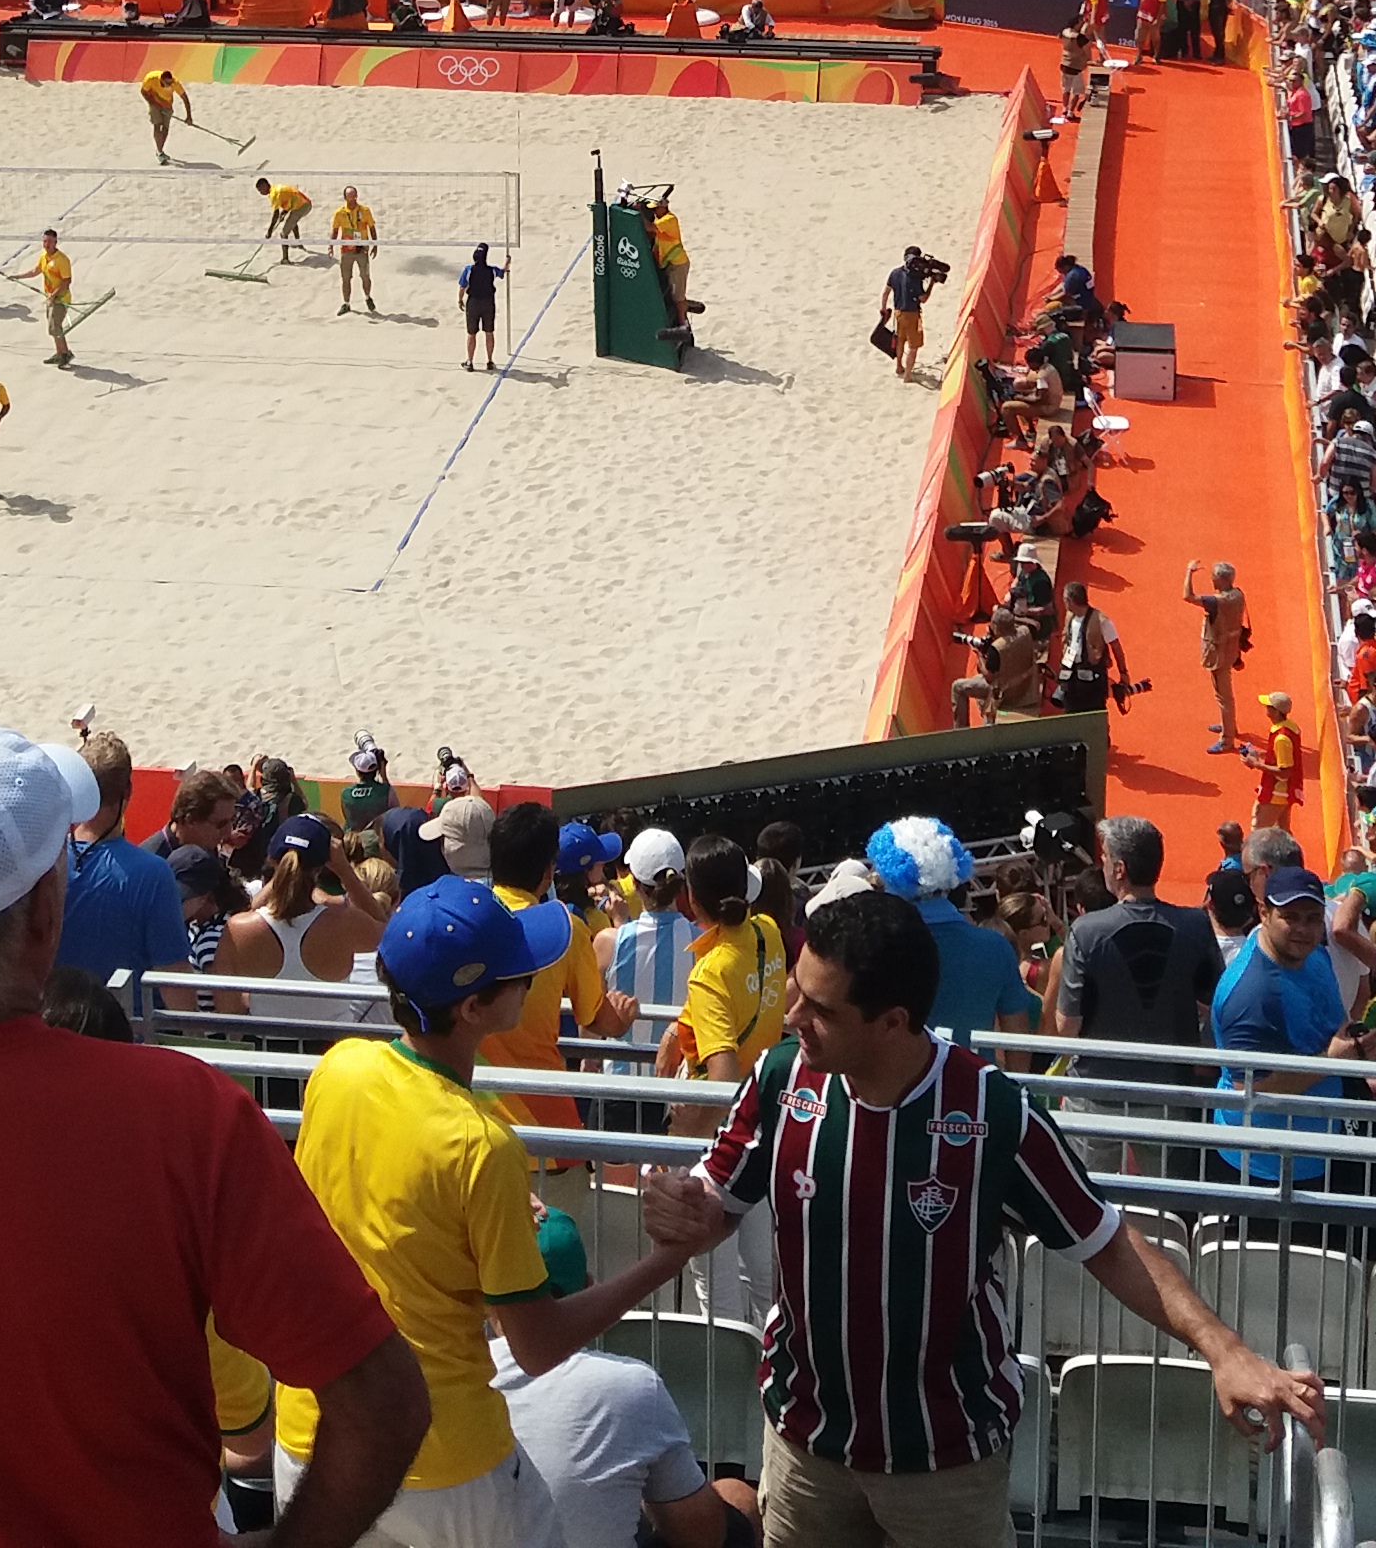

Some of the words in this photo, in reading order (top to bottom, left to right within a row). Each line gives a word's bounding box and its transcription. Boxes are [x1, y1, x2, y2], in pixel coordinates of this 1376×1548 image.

[967, 16, 981, 25] AUG
[594, 234, 605, 276] Rio2016
[781, 1093, 826, 1116] FRESCATTO
[930, 1123, 984, 1135] FRESCATTO
